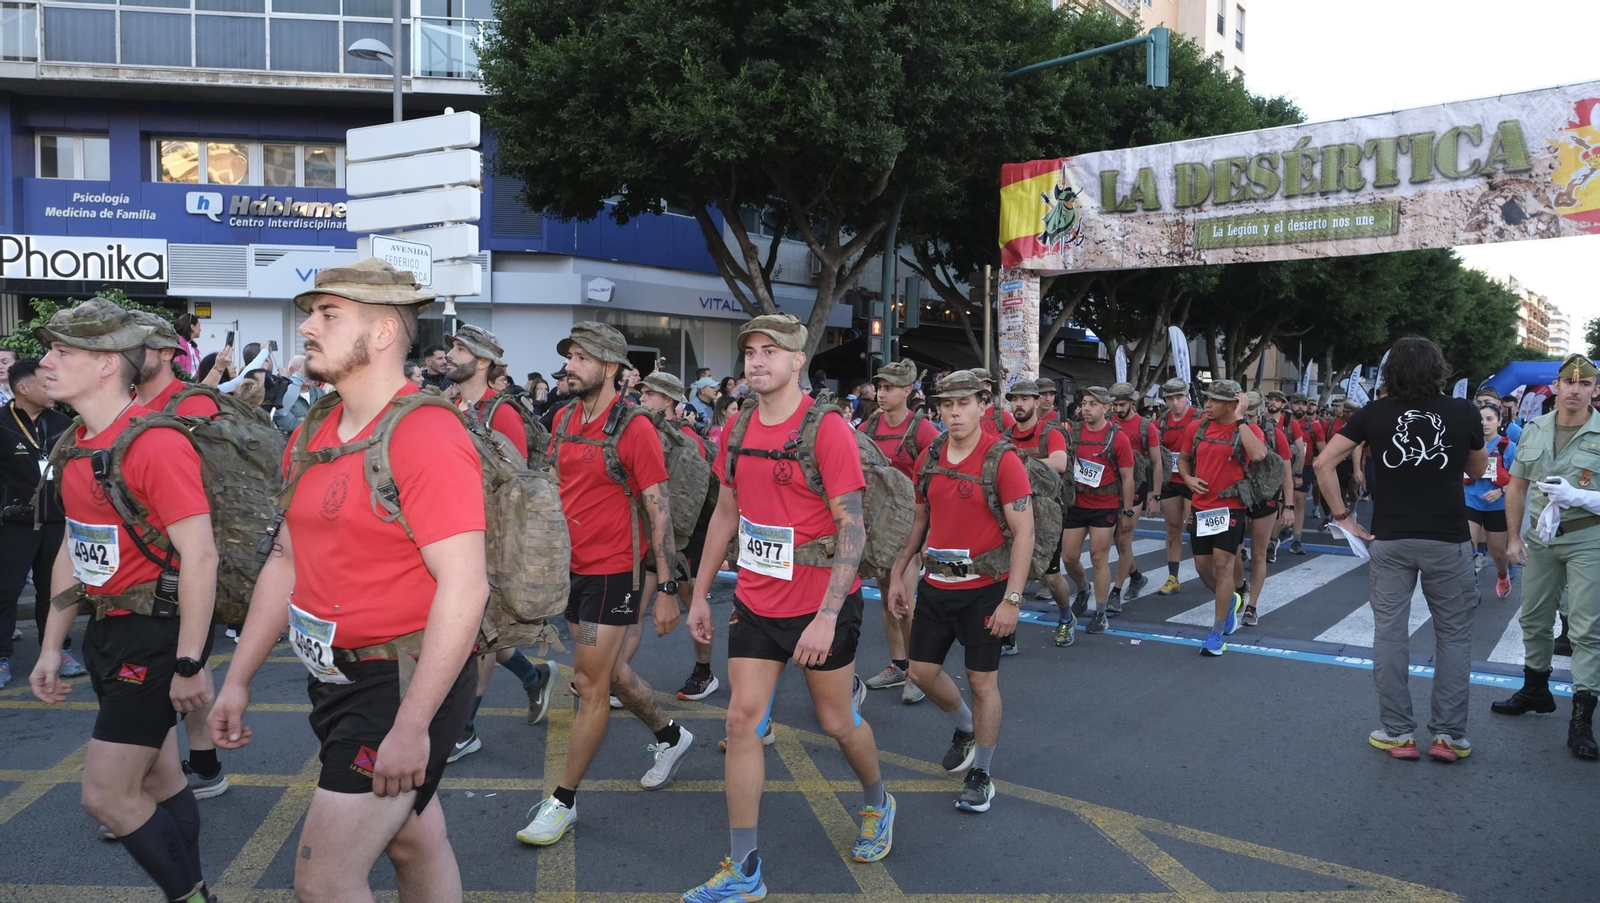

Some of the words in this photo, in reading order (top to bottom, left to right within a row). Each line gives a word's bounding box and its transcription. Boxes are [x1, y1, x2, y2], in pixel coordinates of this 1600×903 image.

[1100, 167, 1162, 213] LA
[1173, 119, 1533, 208] DESÉRTICA
[73, 193, 130, 206] Psicología
[229, 193, 347, 218] Háblame
[45, 207, 97, 218] Medicina
[99, 208, 114, 219] de
[229, 217, 265, 228] Centro
[268, 218, 347, 230] Interdisciplinar
[1212, 225, 1224, 238] La
[1227, 222, 1258, 239] Legión
[1263, 224, 1270, 236] y
[1274, 220, 1284, 233] el
[1287, 217, 1327, 232] desierto
[1332, 216, 1350, 228] nos
[1356, 214, 1375, 226] une
[0, 235, 164, 280] Phonika
[390, 244, 429, 257] AVENIDA
[385, 254, 420, 270] FEDERICO
[414, 271, 428, 283] RCA
[1079, 465, 1098, 479] 4957
[1204, 516, 1226, 528] 4960
[74, 541, 109, 566] 4942
[747, 537, 783, 561] 4977
[295, 630, 327, 668] 4962
